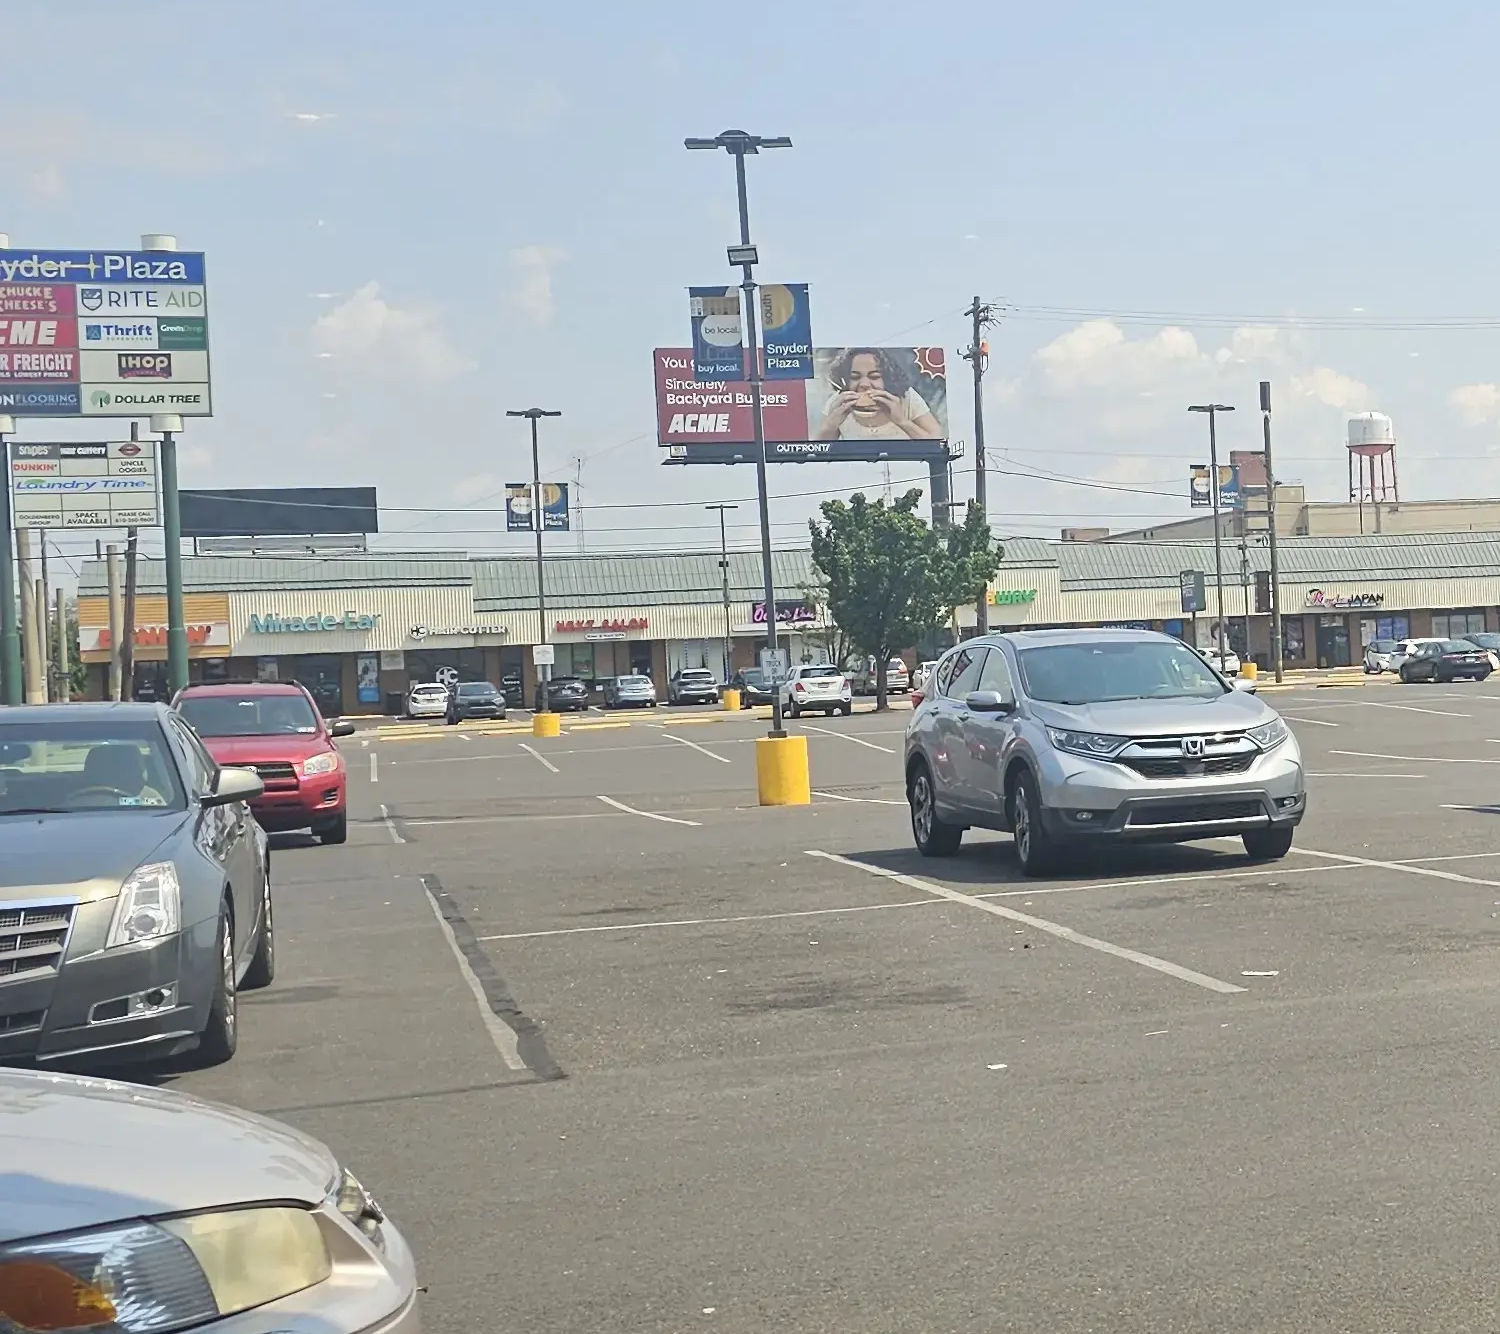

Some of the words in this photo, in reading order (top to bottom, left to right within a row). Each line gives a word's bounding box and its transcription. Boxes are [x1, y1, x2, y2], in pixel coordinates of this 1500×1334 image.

[0, 255, 71, 282] yder
[104, 255, 187, 279] Plaza
[44, 288, 53, 299] E
[108, 291, 158, 307] RITE
[165, 291, 203, 308] AID
[762, 294, 773, 325] south
[0, 321, 58, 345] ME
[103, 325, 152, 336] Thrift
[767, 343, 808, 355] Snyder
[13, 354, 73, 370] FREIGHT
[121, 356, 169, 371] IHOP
[661, 357, 687, 368] You
[768, 359, 800, 368] Plaza
[698, 365, 714, 373] buy
[16, 394, 77, 403] FLOORING
[115, 395, 164, 403] DOLLAR
[169, 395, 200, 403] TREE
[667, 393, 732, 407] Backyard
[736, 393, 788, 407] Bugers
[13, 463, 57, 471] DUNKIN'
[15, 480, 97, 491] Laundry
[101, 480, 146, 488] Time
[986, 589, 1038, 606] BWAY
[1349, 593, 1384, 605] JAPAN
[250, 611, 382, 633] Miracle-Ear
[602, 617, 648, 630] SALON
[412, 625, 428, 638] HC
[428, 627, 457, 636] HAIR
[458, 625, 510, 635] CUTTER
